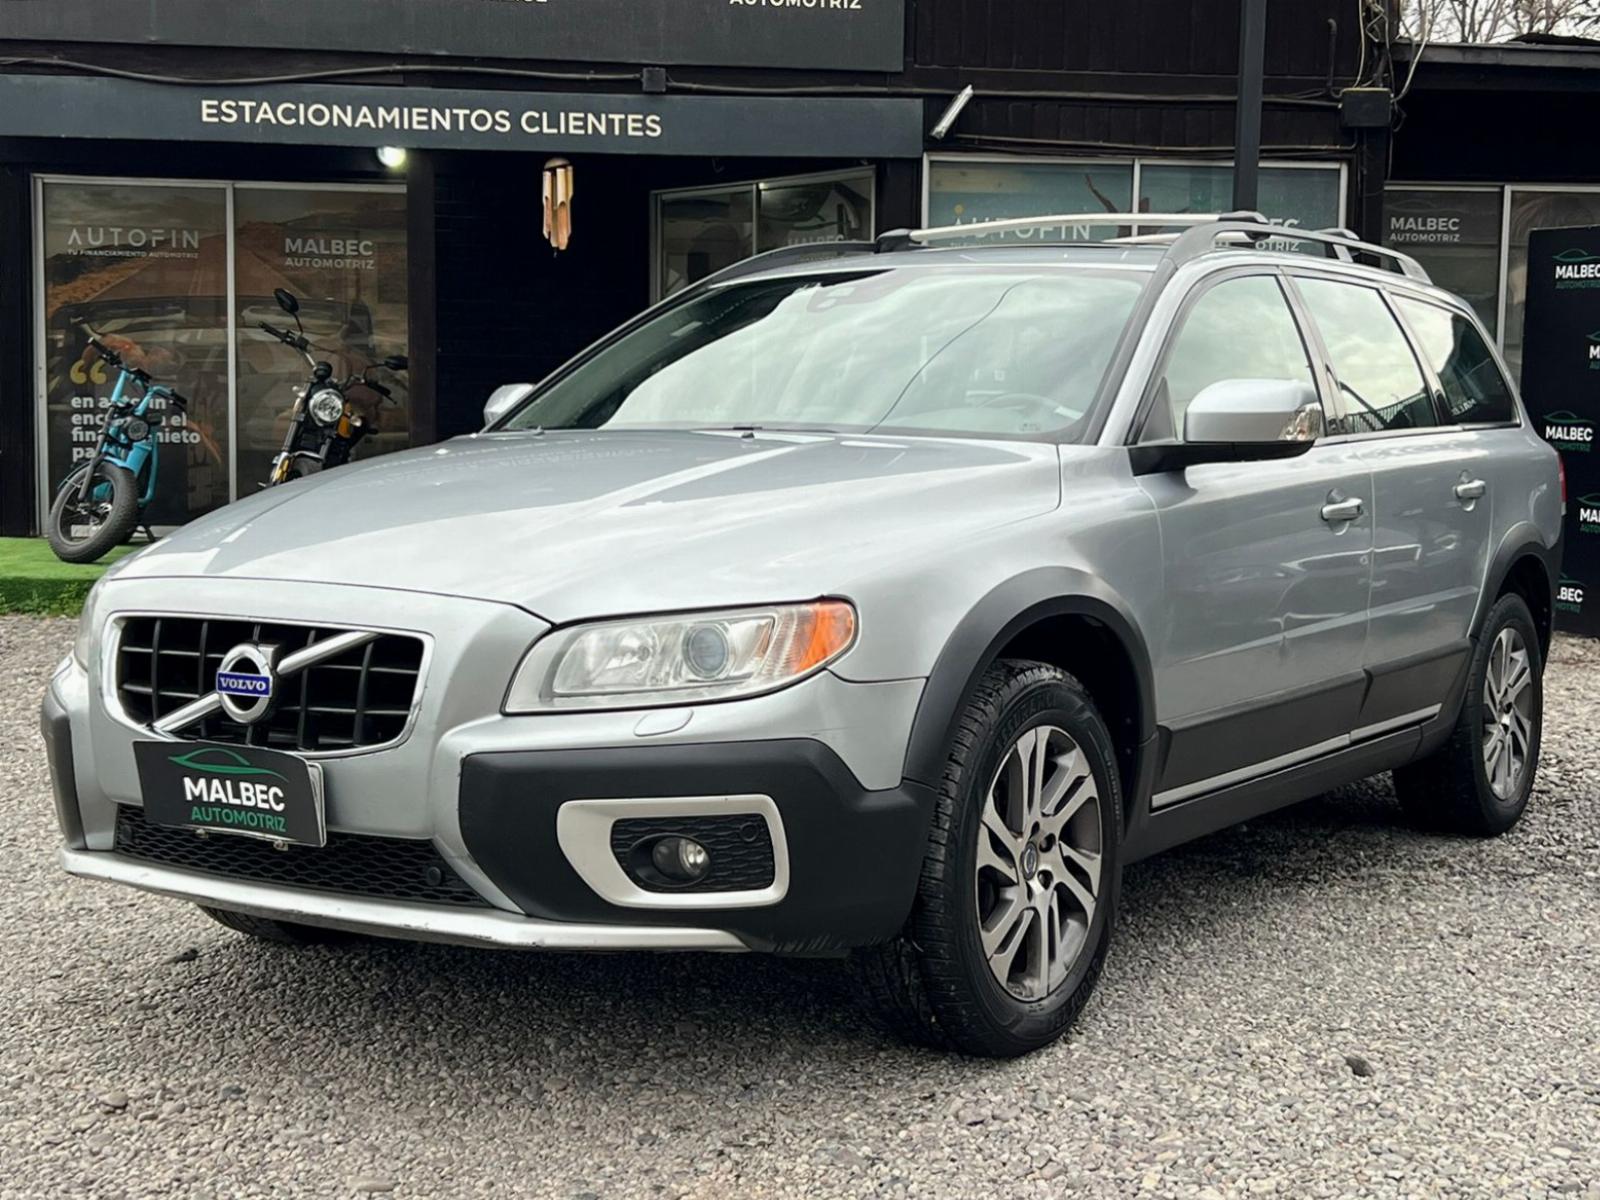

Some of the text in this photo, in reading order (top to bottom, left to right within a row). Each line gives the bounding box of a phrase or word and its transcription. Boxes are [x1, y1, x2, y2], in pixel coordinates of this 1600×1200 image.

[201, 100, 662, 137] ESTACIONAMIENTOS CLIENTES
[1390, 217, 1460, 231] MALBEC
[67, 227, 199, 249] AUTOFIN
[1389, 233, 1460, 242] AUTOMOTRIZ
[285, 238, 373, 256] MALBEC
[284, 257, 375, 270] AUTOMOTRIZ
[1555, 264, 1600, 279] MALBEC
[71, 396, 93, 409] en
[170, 411, 187, 427] el
[1545, 425, 1593, 441] MALBEC
[1557, 587, 1584, 603] BEC
[219, 676, 267, 692] VOLVO
[182, 776, 286, 812] MALBEC
[190, 806, 287, 833] AUTOMOTRIZ
